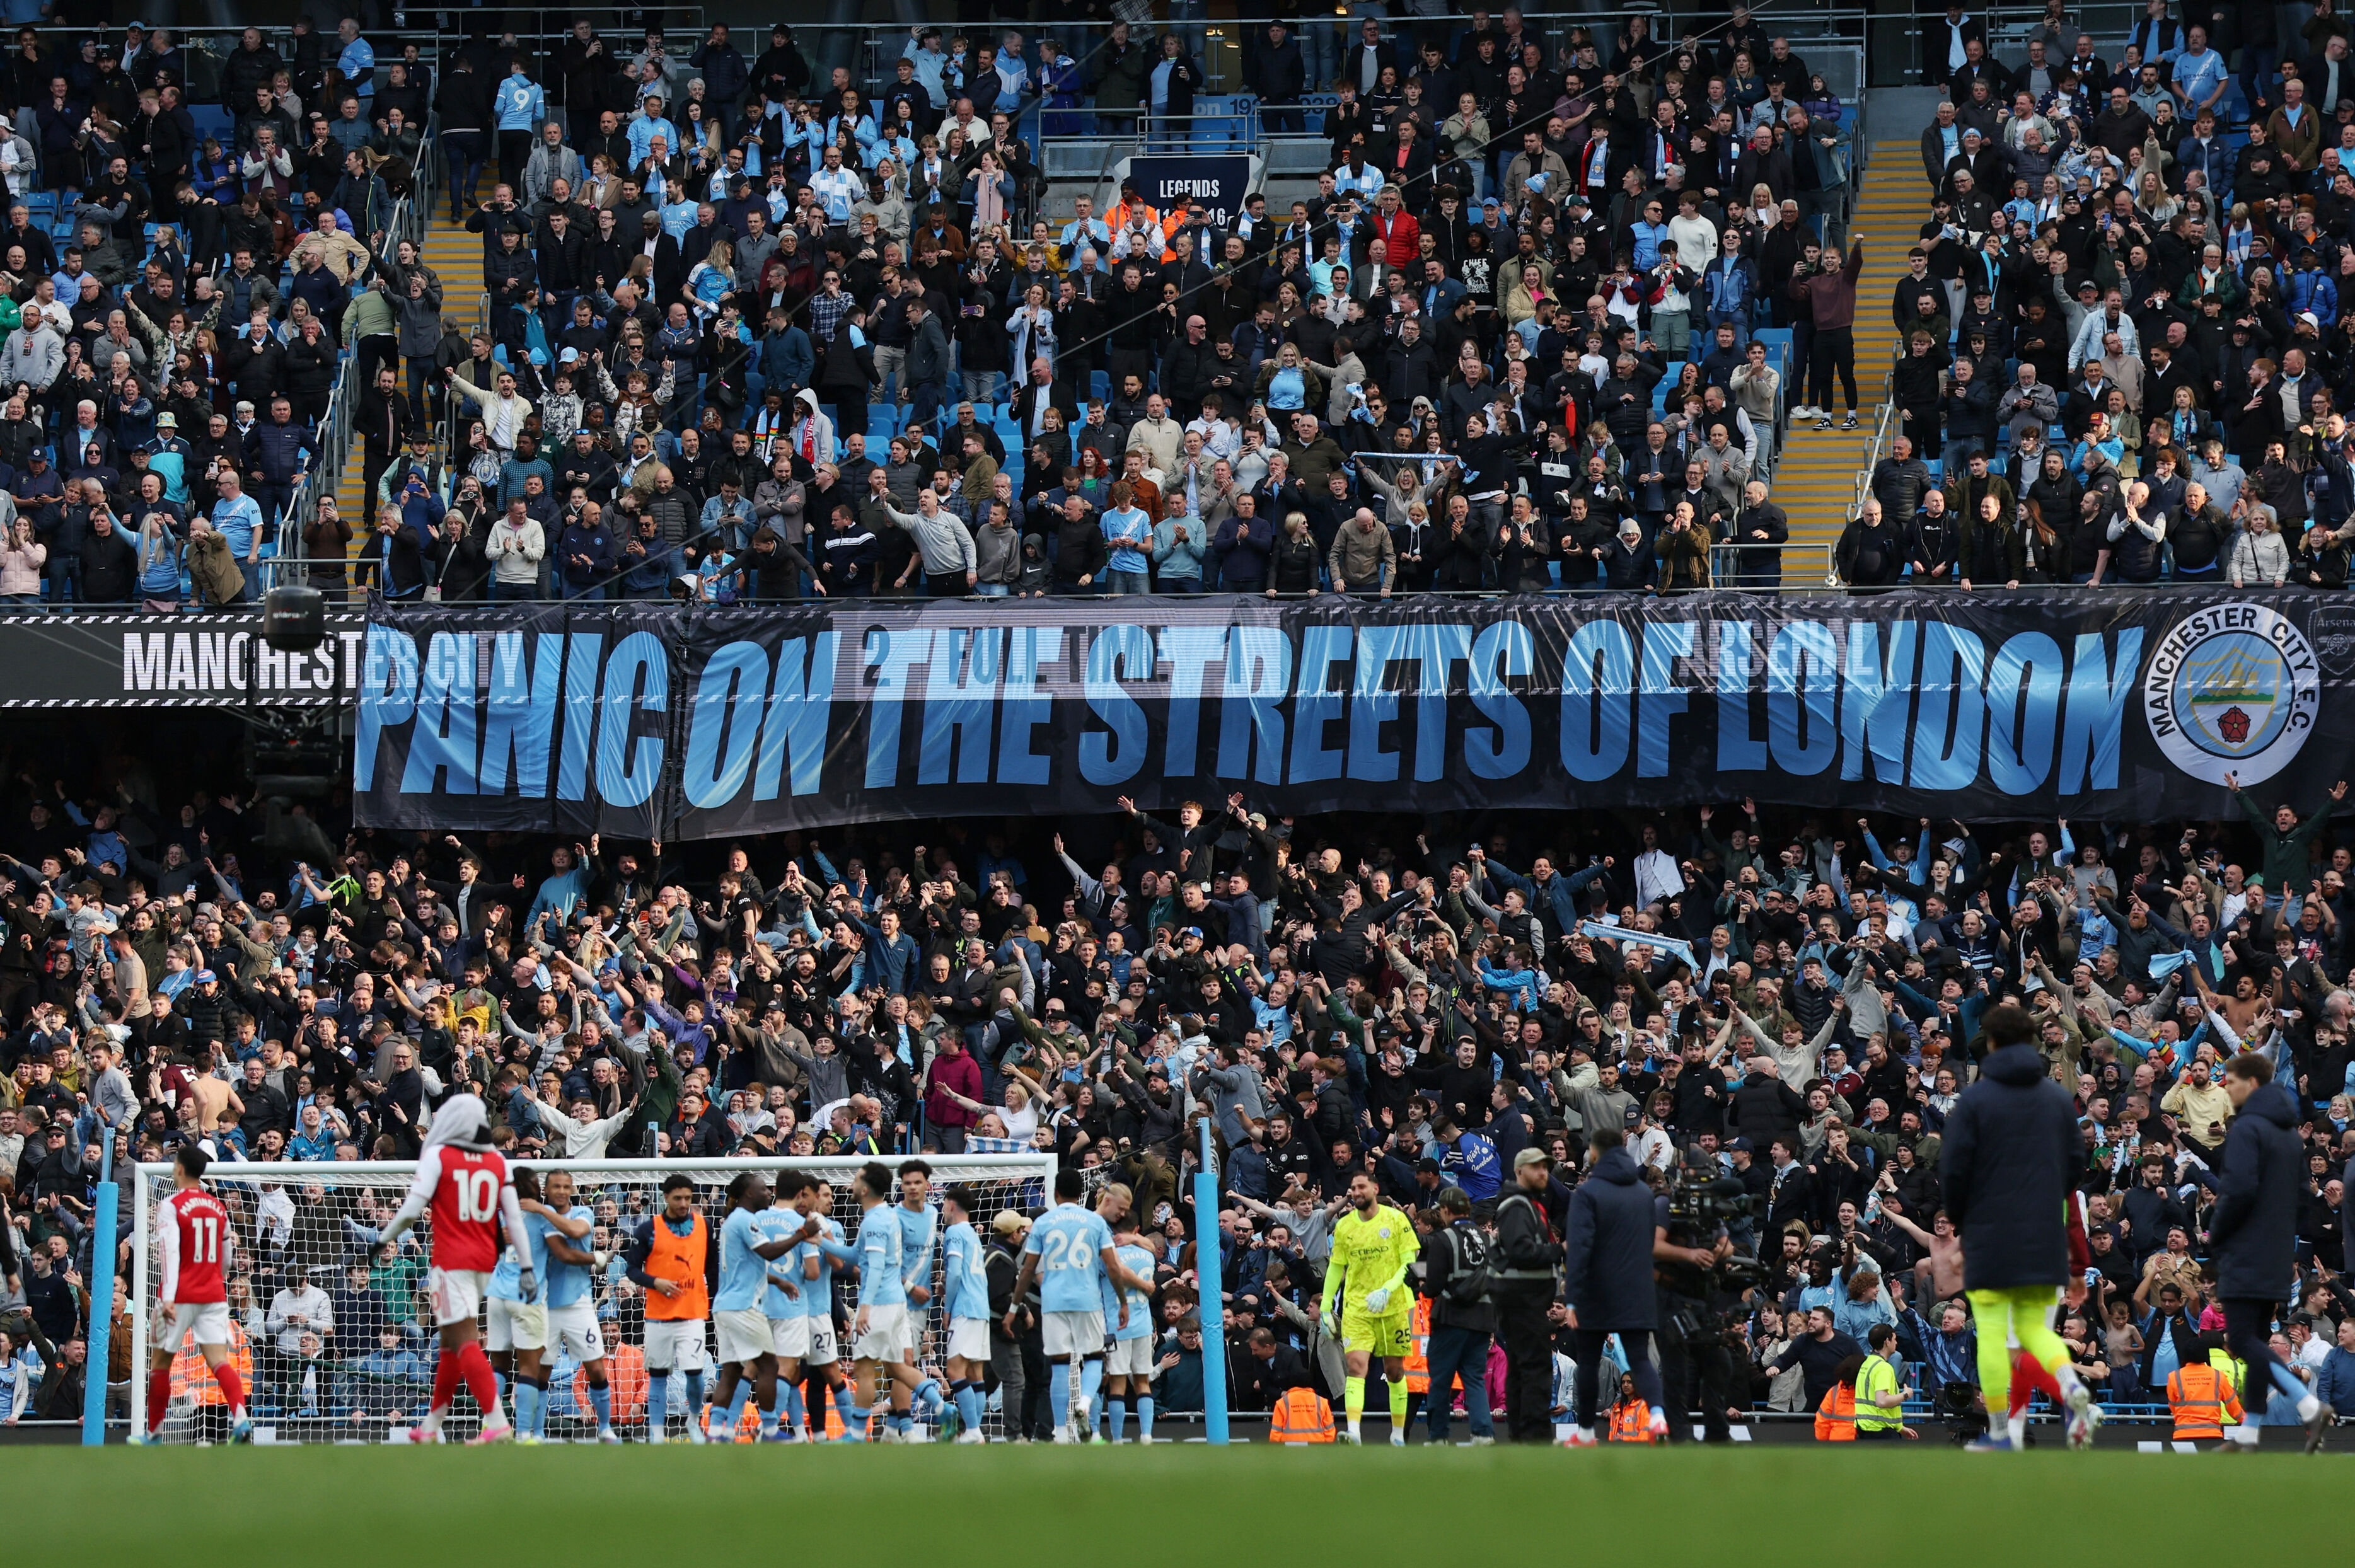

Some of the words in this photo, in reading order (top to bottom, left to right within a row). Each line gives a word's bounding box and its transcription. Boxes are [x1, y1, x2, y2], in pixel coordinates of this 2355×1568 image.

[514, 89, 529, 110] 9
[1160, 179, 1220, 198] LEGENDS
[124, 631, 418, 690] MANCHESTER
[429, 630, 524, 688] CITY
[862, 625, 890, 687] 2
[947, 626, 1048, 684] FULL
[1062, 625, 1168, 683] TIME
[1678, 617, 1873, 677] ARSENAL
[2271, 621, 2315, 672] CITY
[2148, 607, 2257, 738] MANCHESTER
[355, 621, 669, 808] PANIC
[683, 630, 842, 809] ON
[864, 625, 1062, 789] THE
[1078, 620, 1534, 787] STREETS
[1559, 619, 1696, 781] OF
[1716, 619, 2143, 796] LONDON
[2286, 689, 2315, 733] F.C.
[1597, 926, 1653, 940] MANCHESTER
[453, 1168, 499, 1223] 10
[179, 1197, 224, 1217] MARTINELLI
[1050, 1213, 1087, 1226] SAVINHO
[192, 1217, 217, 1263] 11
[1045, 1228, 1093, 1271] 26
[1350, 1245, 1389, 1257] ETIHAD
[586, 1327, 596, 1344] 6
[814, 1332, 831, 1349] 27
[1395, 1328, 1411, 1344] 25
[693, 1339, 703, 1354] 7
